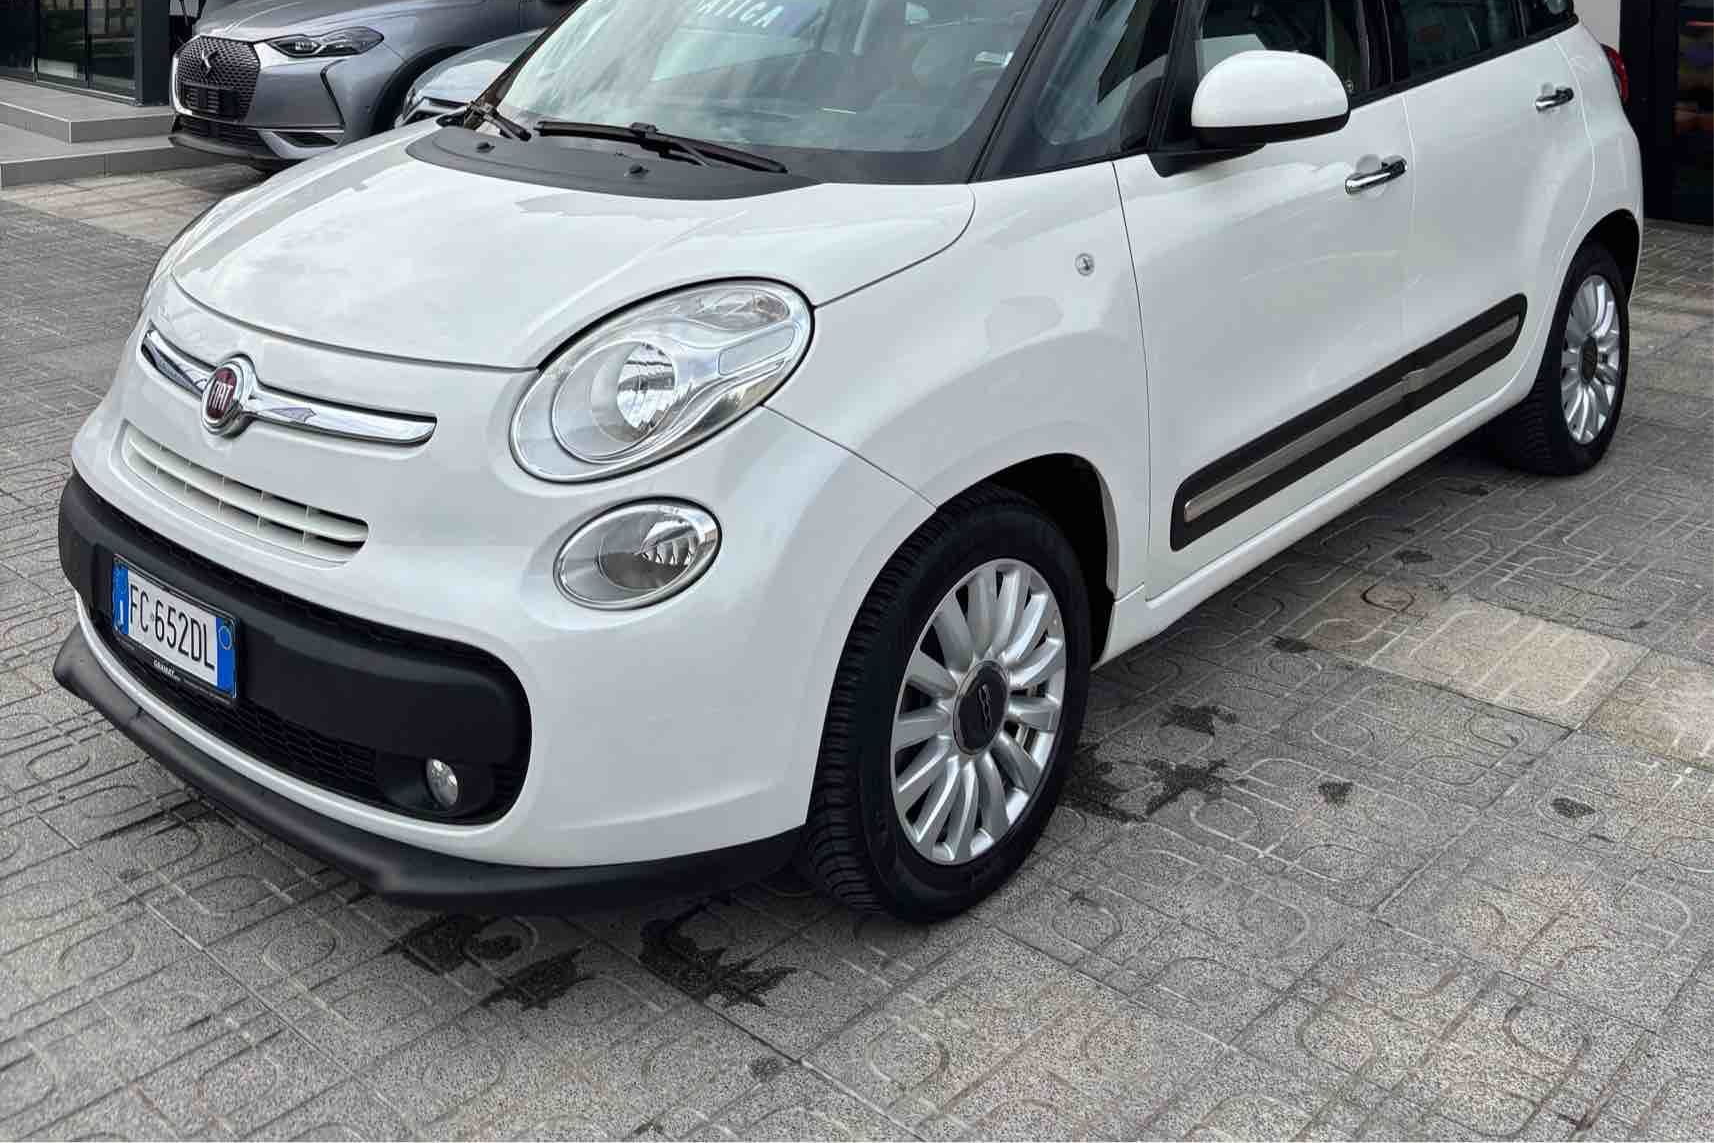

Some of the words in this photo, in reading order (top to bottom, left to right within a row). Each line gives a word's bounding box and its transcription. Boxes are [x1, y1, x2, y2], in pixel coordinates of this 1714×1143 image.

[208, 379, 235, 411] FIAT
[129, 583, 150, 634] FC
[154, 600, 216, 671] 652DL
